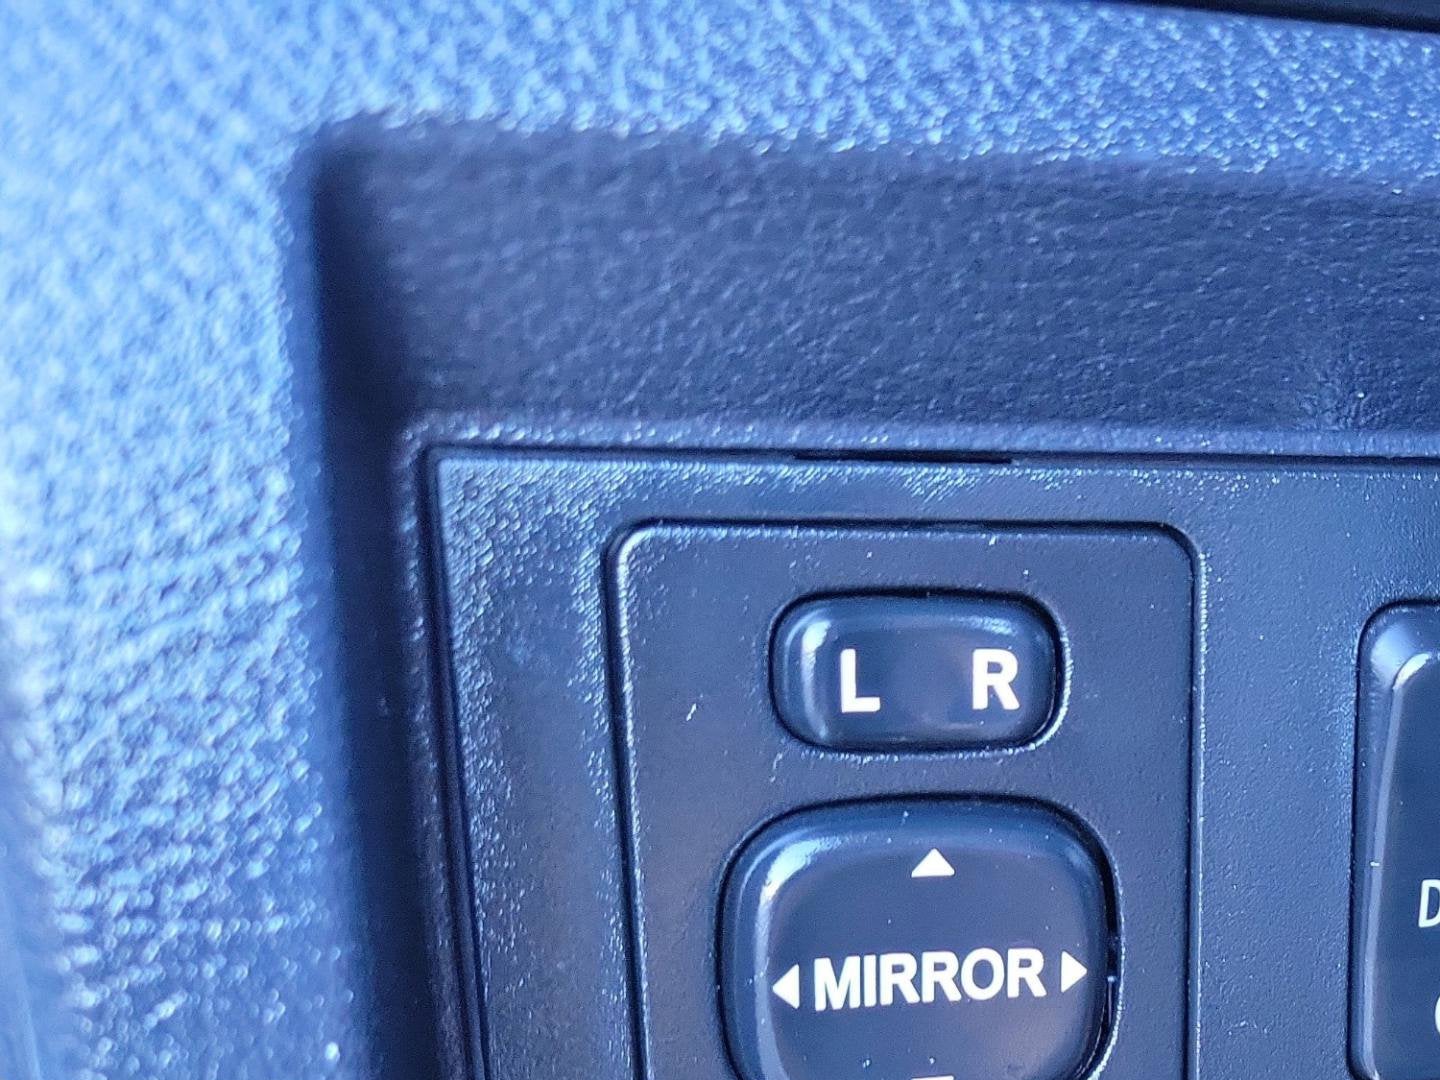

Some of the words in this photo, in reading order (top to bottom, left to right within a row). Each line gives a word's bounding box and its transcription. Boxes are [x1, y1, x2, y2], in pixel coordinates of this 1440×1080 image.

[840, 648, 881, 713] L
[972, 647, 1020, 711] R
[813, 947, 1047, 1012] MIRROR
